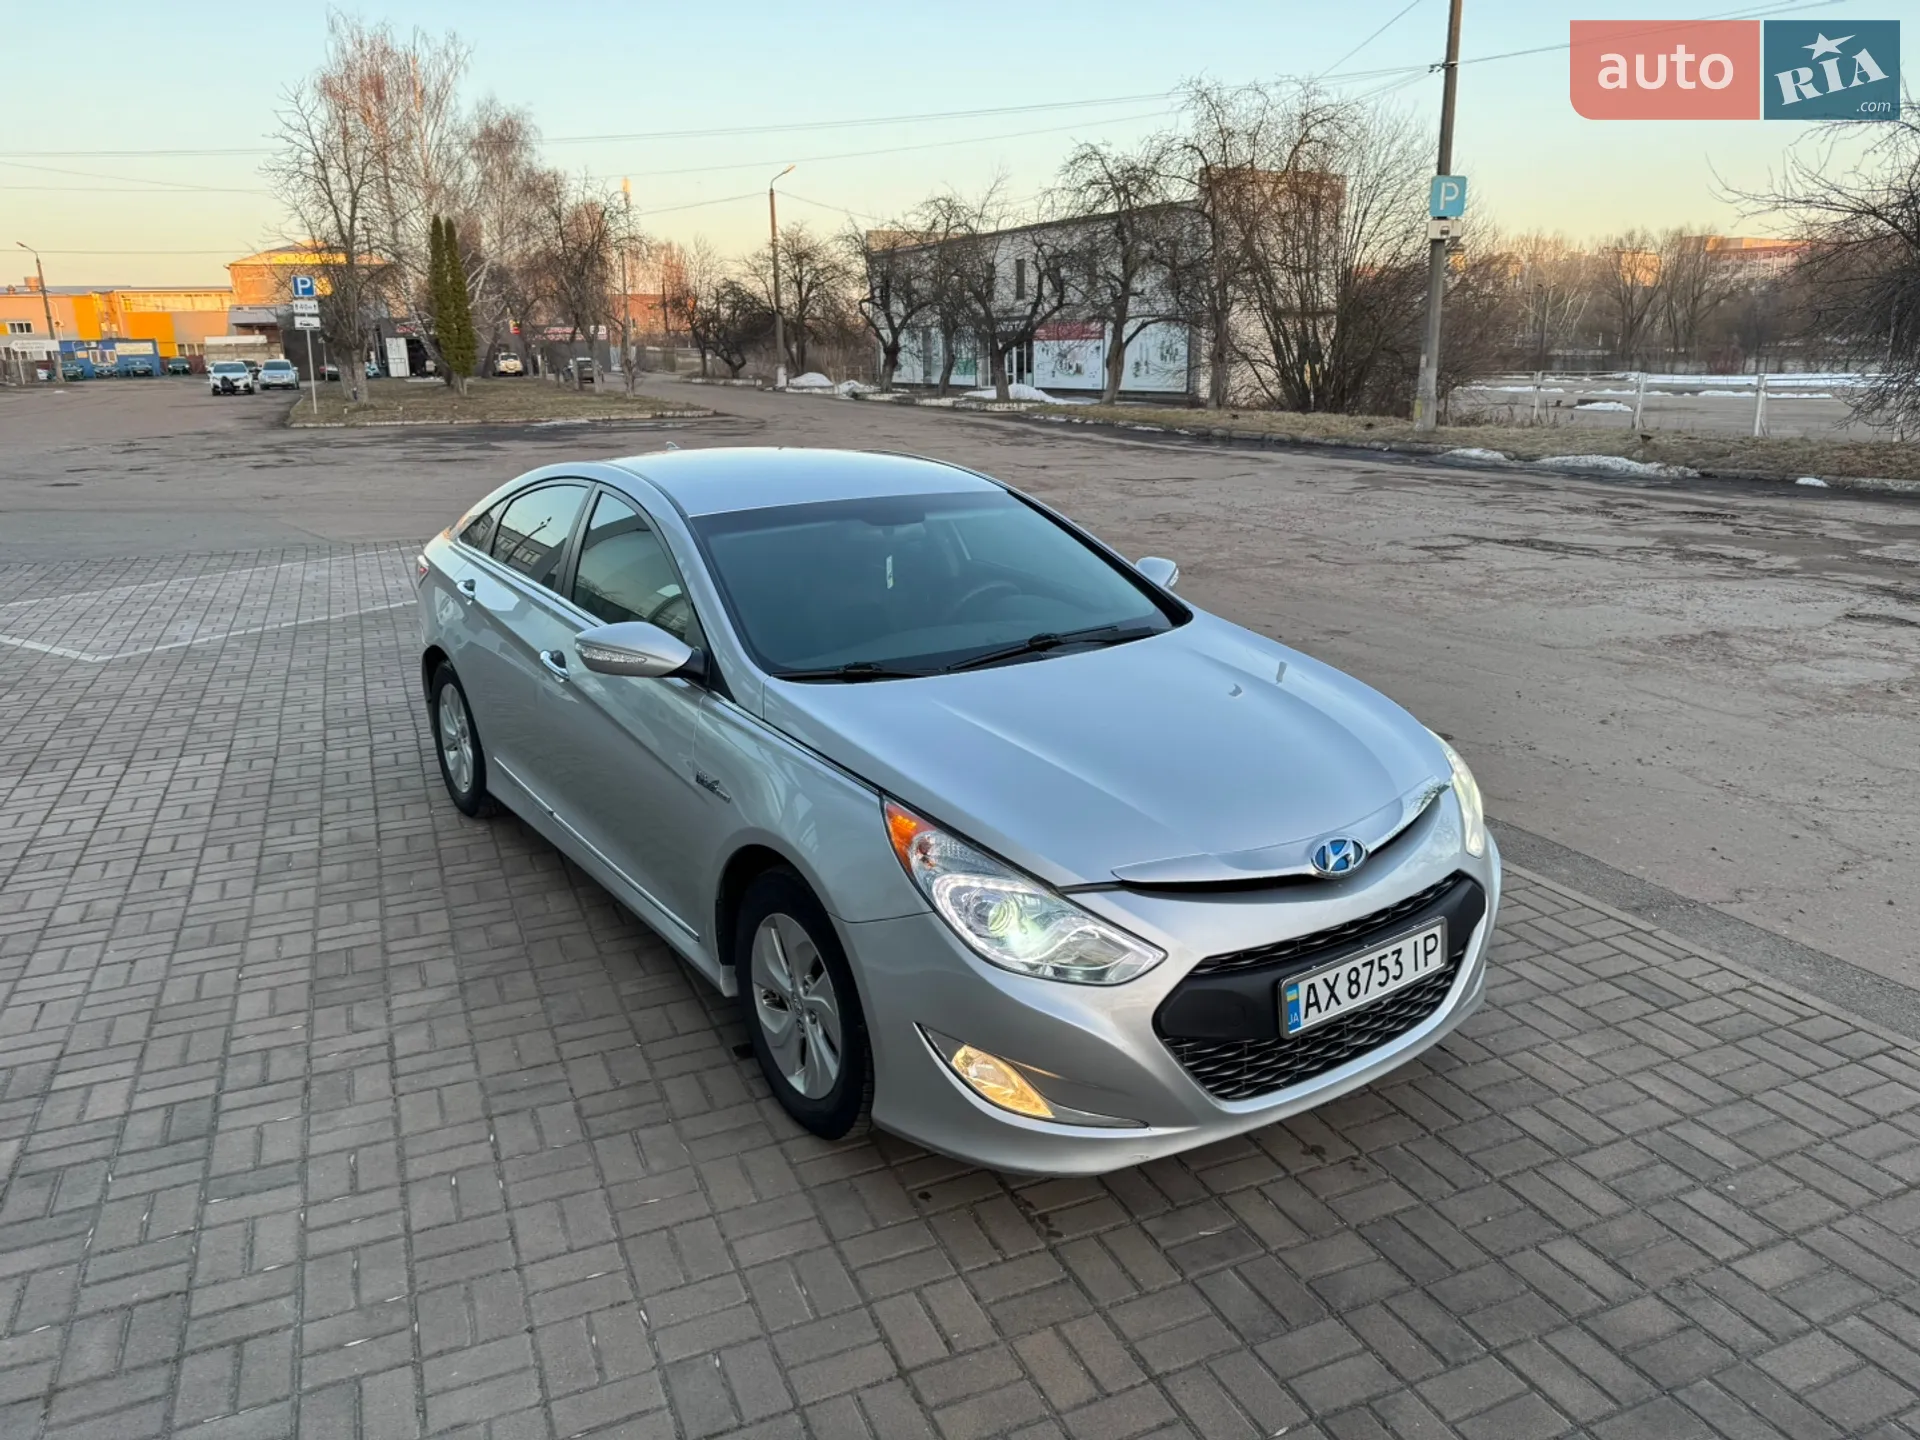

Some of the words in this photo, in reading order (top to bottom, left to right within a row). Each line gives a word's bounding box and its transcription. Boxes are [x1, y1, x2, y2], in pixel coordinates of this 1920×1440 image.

[1440, 182, 1460, 210] P
[297, 277, 311, 295] P
[1303, 973, 1342, 1019] AX
[1347, 947, 1403, 1000] 8753
[1413, 933, 1439, 972] IP
